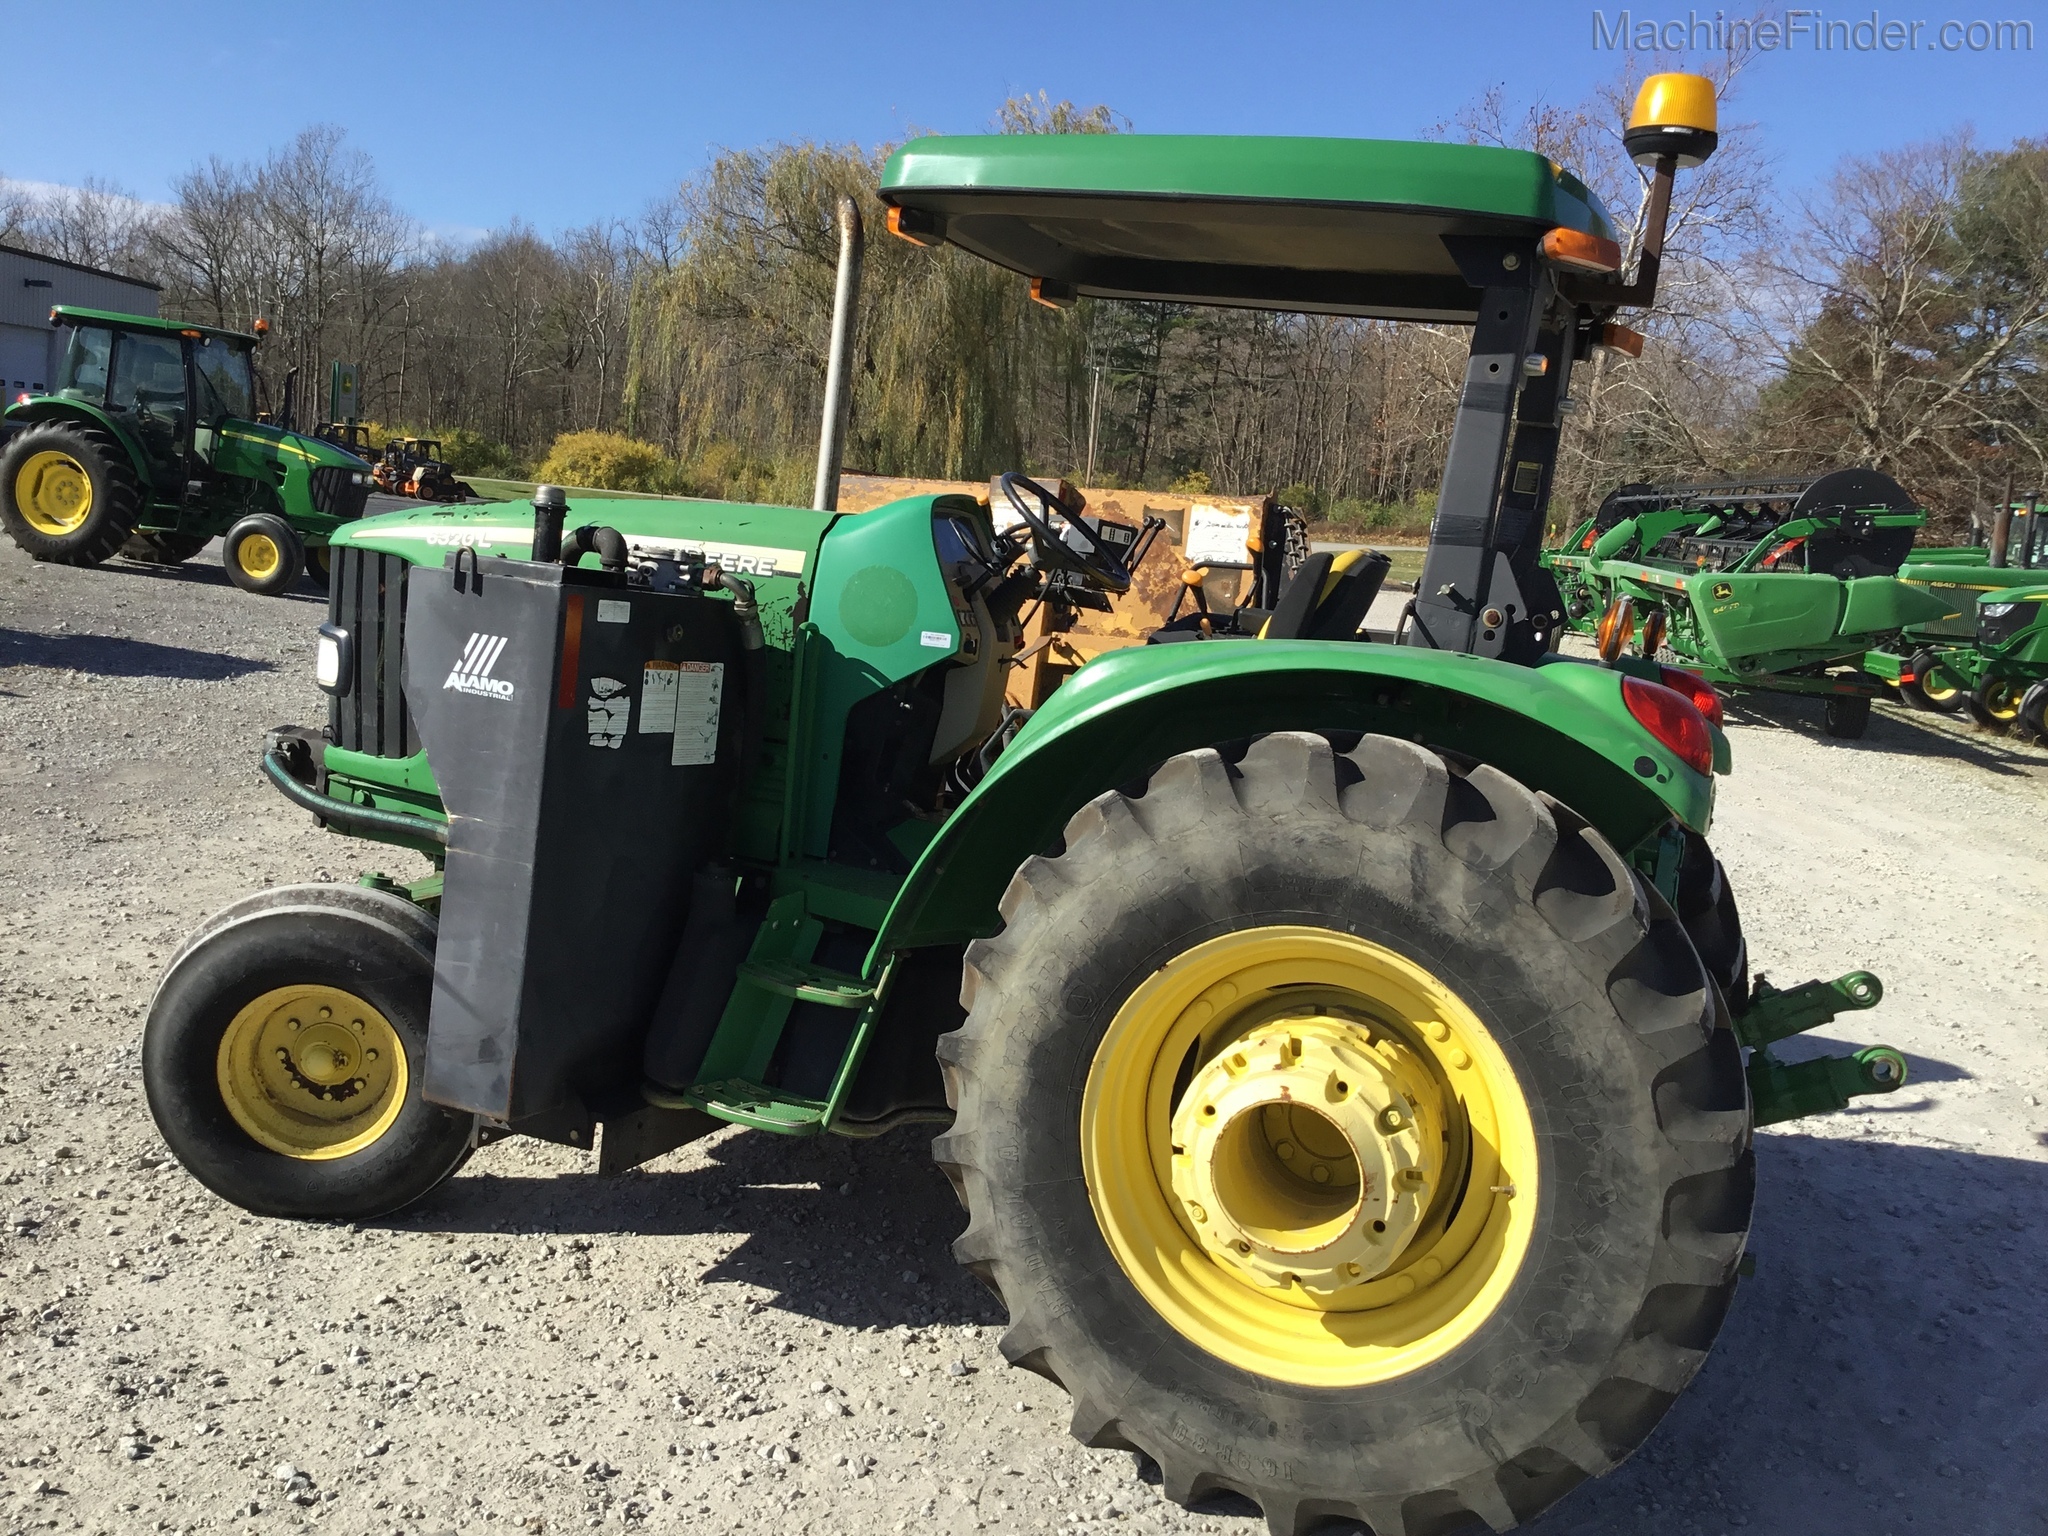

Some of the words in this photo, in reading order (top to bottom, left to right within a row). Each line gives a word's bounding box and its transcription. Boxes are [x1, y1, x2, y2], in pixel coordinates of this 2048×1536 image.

[686, 663, 710, 673] DANGER
[442, 671, 515, 695] ALAMO
[462, 687, 513, 701] INDUSTRIAL
